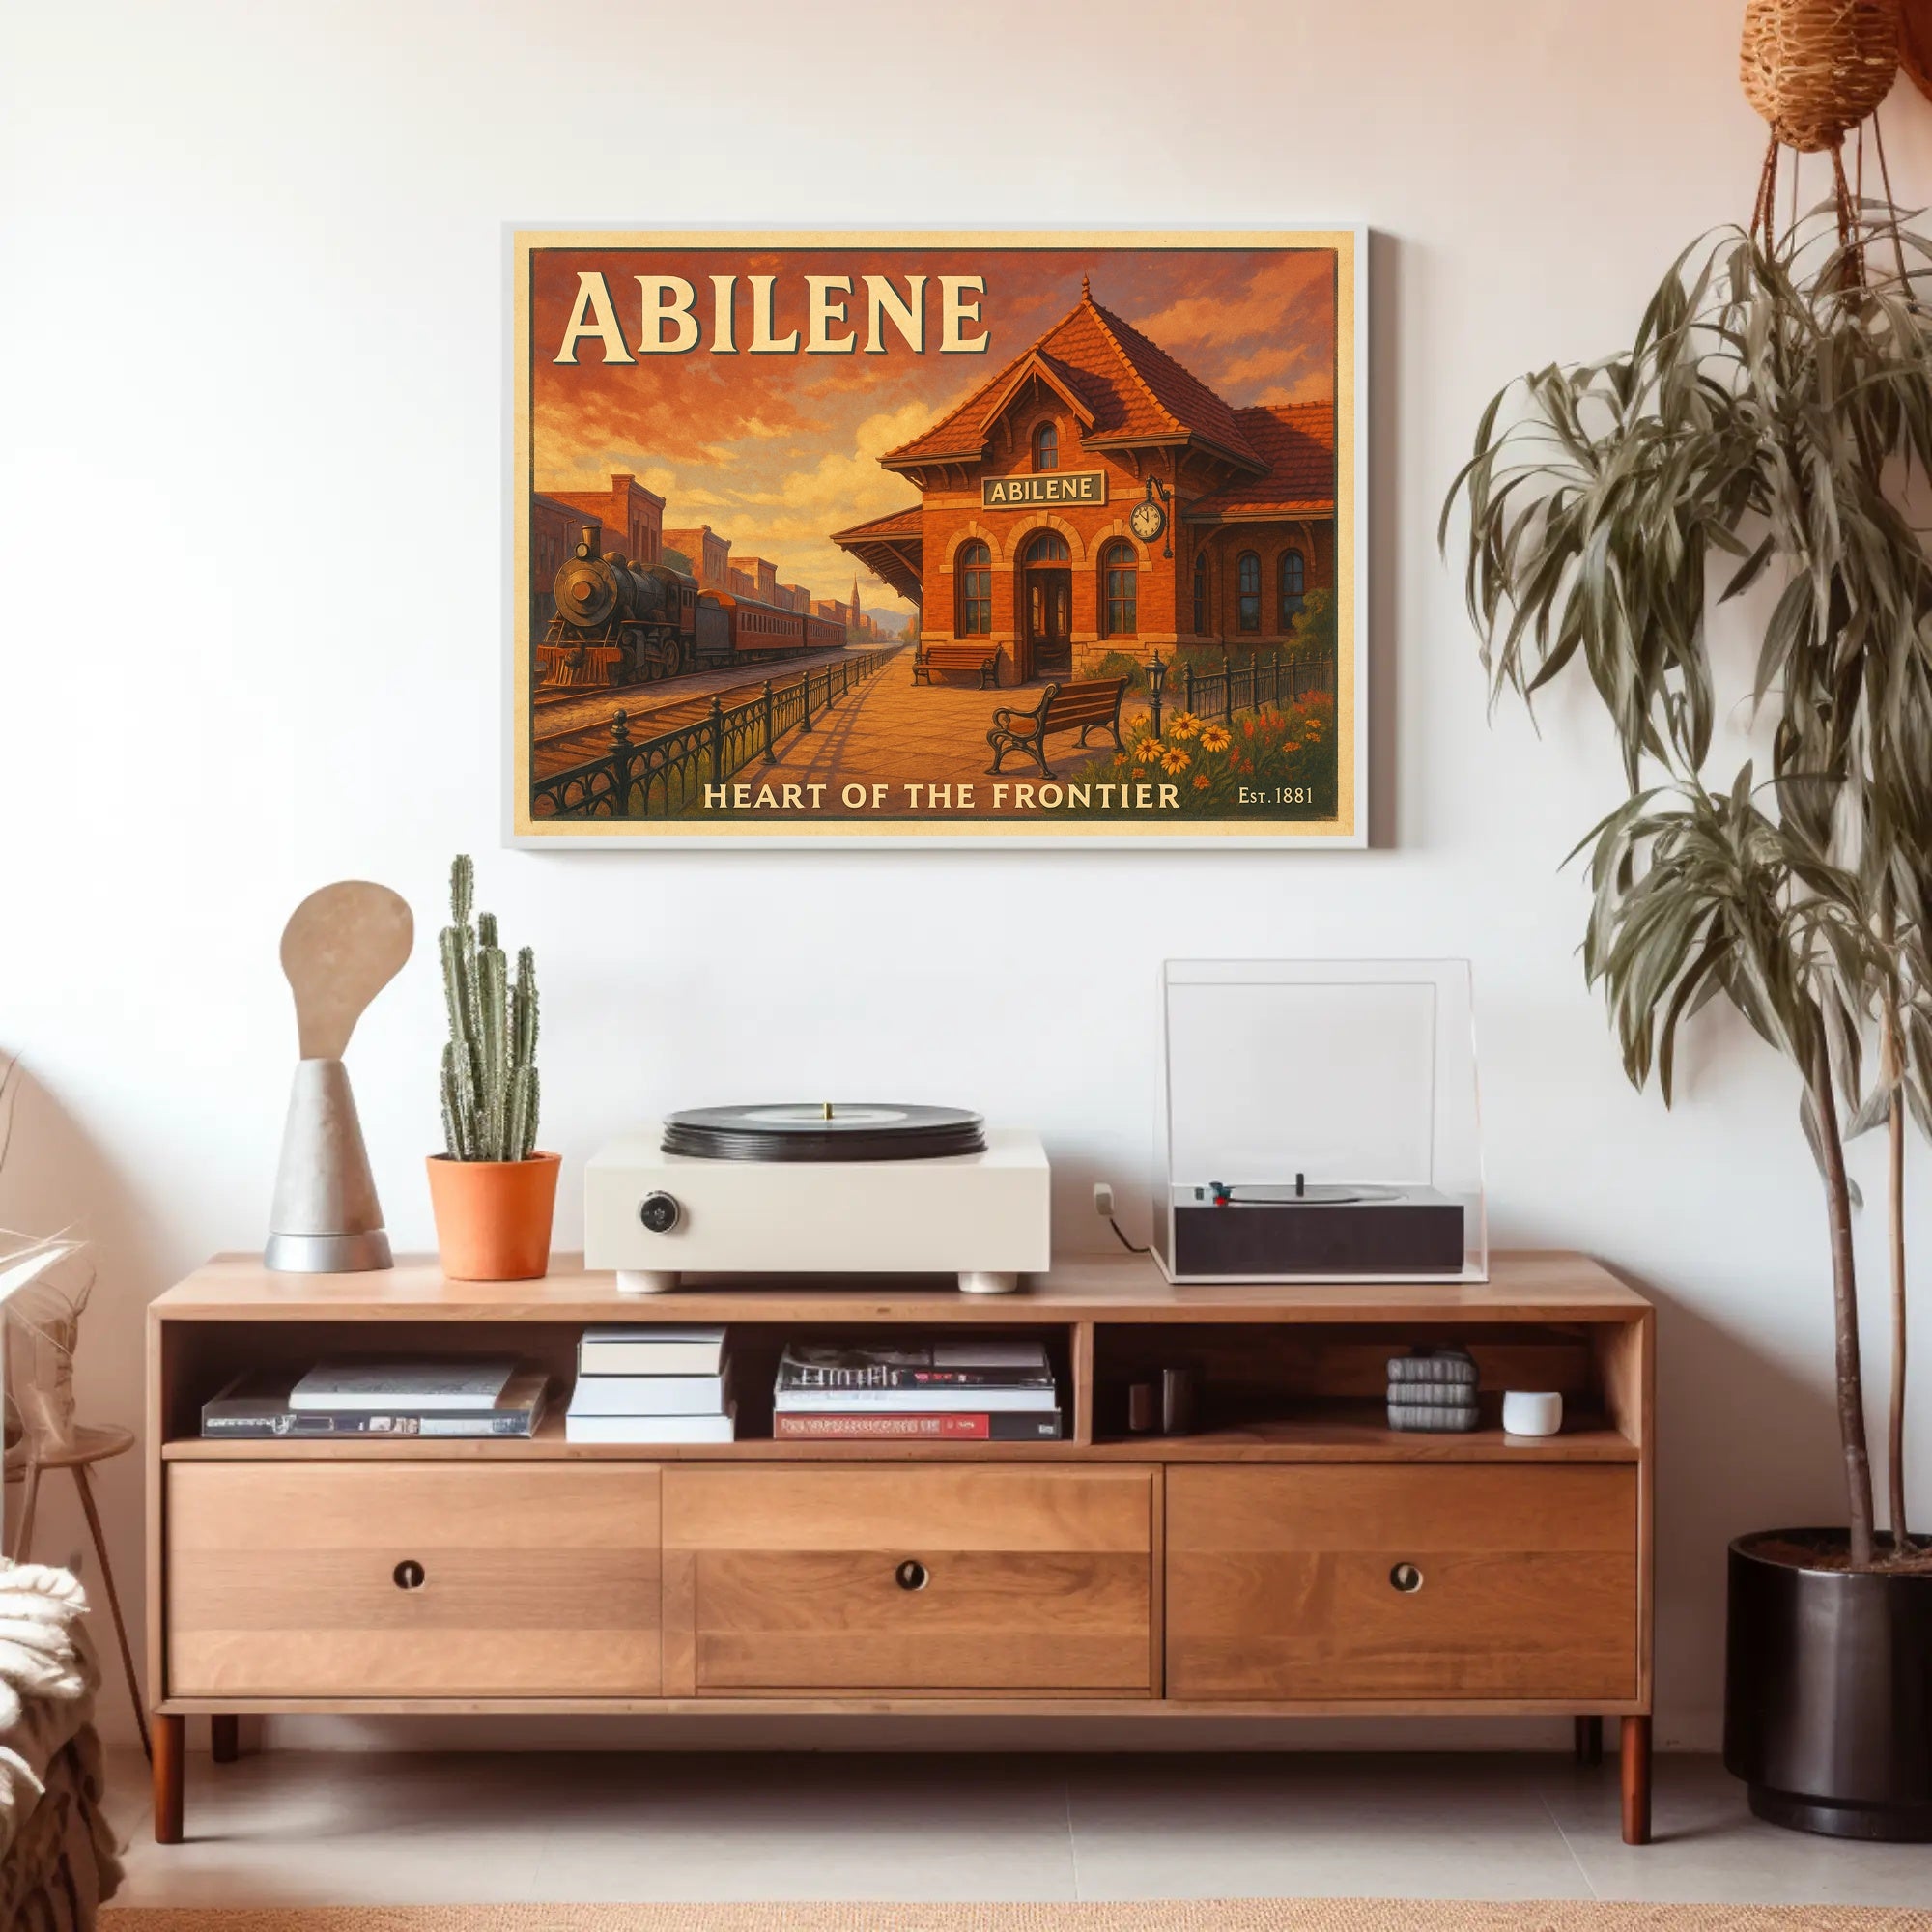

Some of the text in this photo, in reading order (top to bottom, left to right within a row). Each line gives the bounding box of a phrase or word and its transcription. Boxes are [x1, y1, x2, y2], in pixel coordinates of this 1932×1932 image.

[553, 271, 990, 365] ABILENE
[990, 477, 1094, 502] ABILENE
[703, 783, 1181, 809] HEART OF THE FRONTIER
[1275, 786, 1313, 804] 1881
